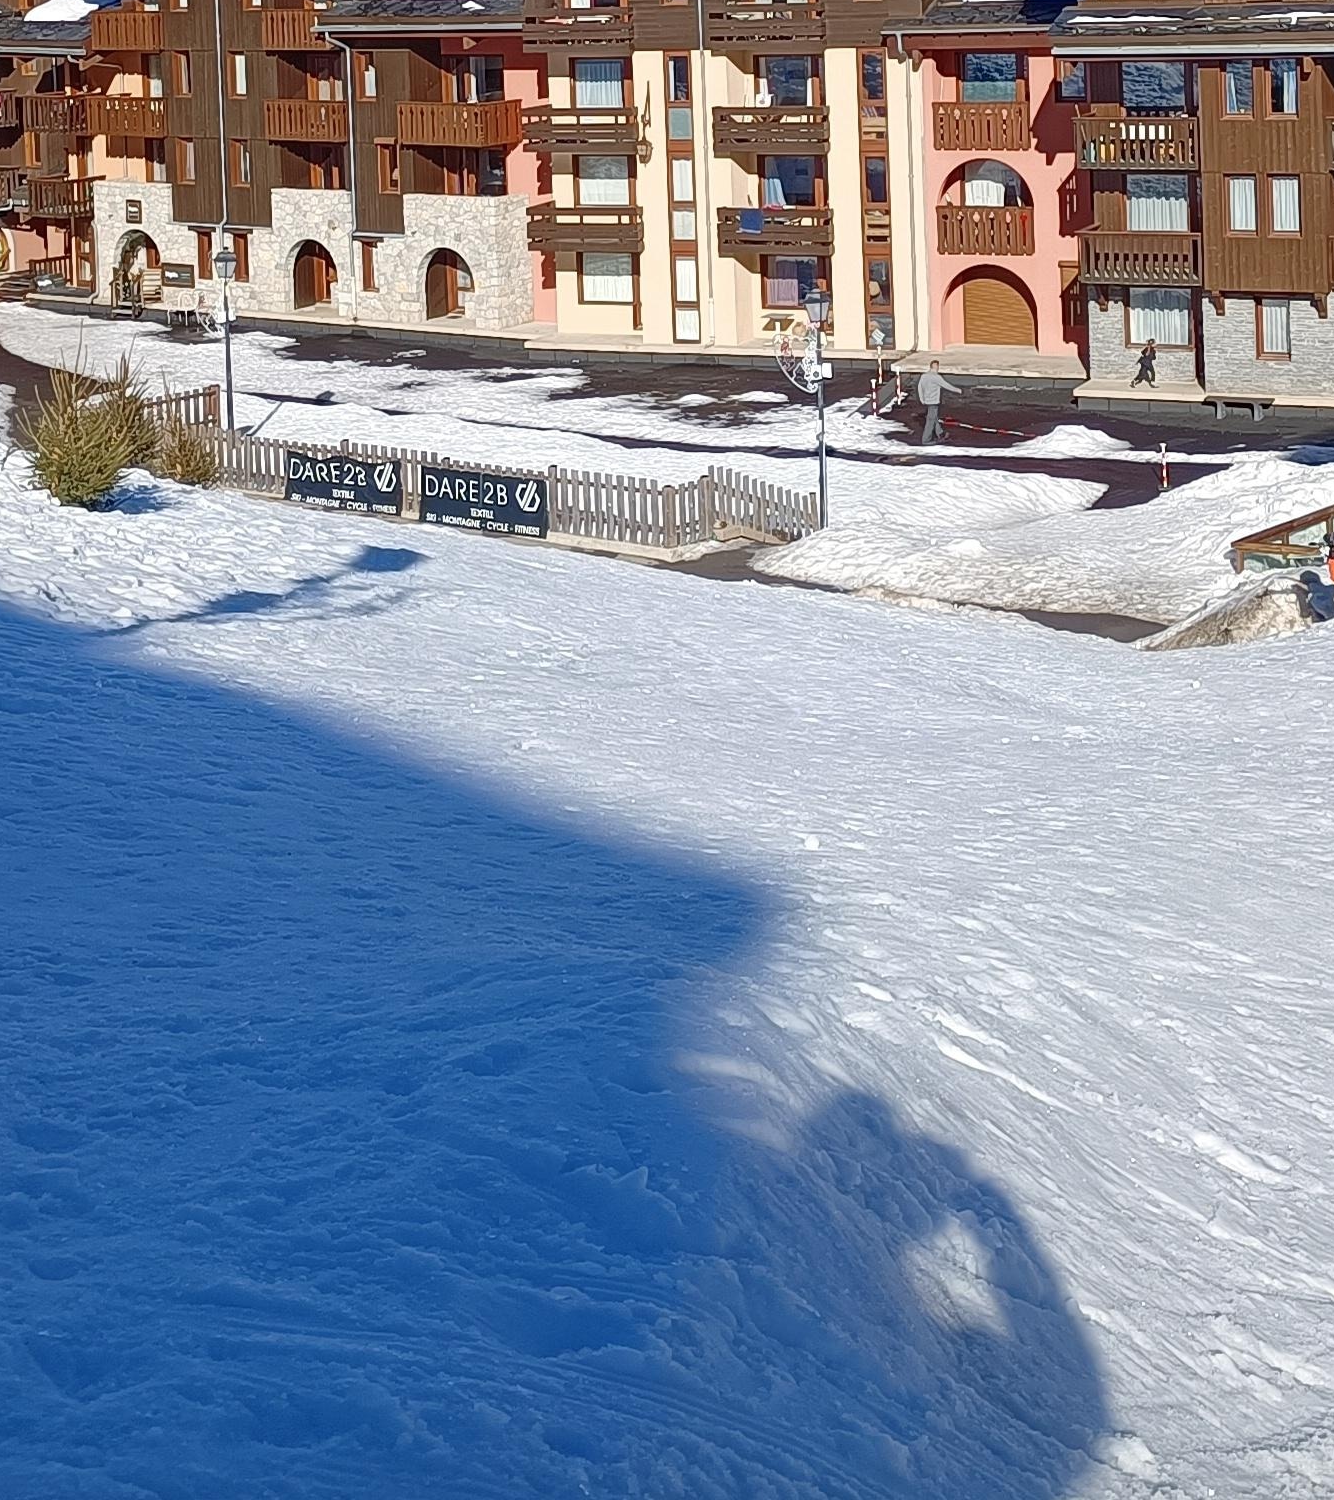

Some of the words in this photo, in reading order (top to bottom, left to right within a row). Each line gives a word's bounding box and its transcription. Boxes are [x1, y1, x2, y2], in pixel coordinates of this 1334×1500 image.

[289, 458, 367, 486] DARE2B
[425, 474, 508, 505] DARE2B
[486, 521, 509, 532] CYCLE
